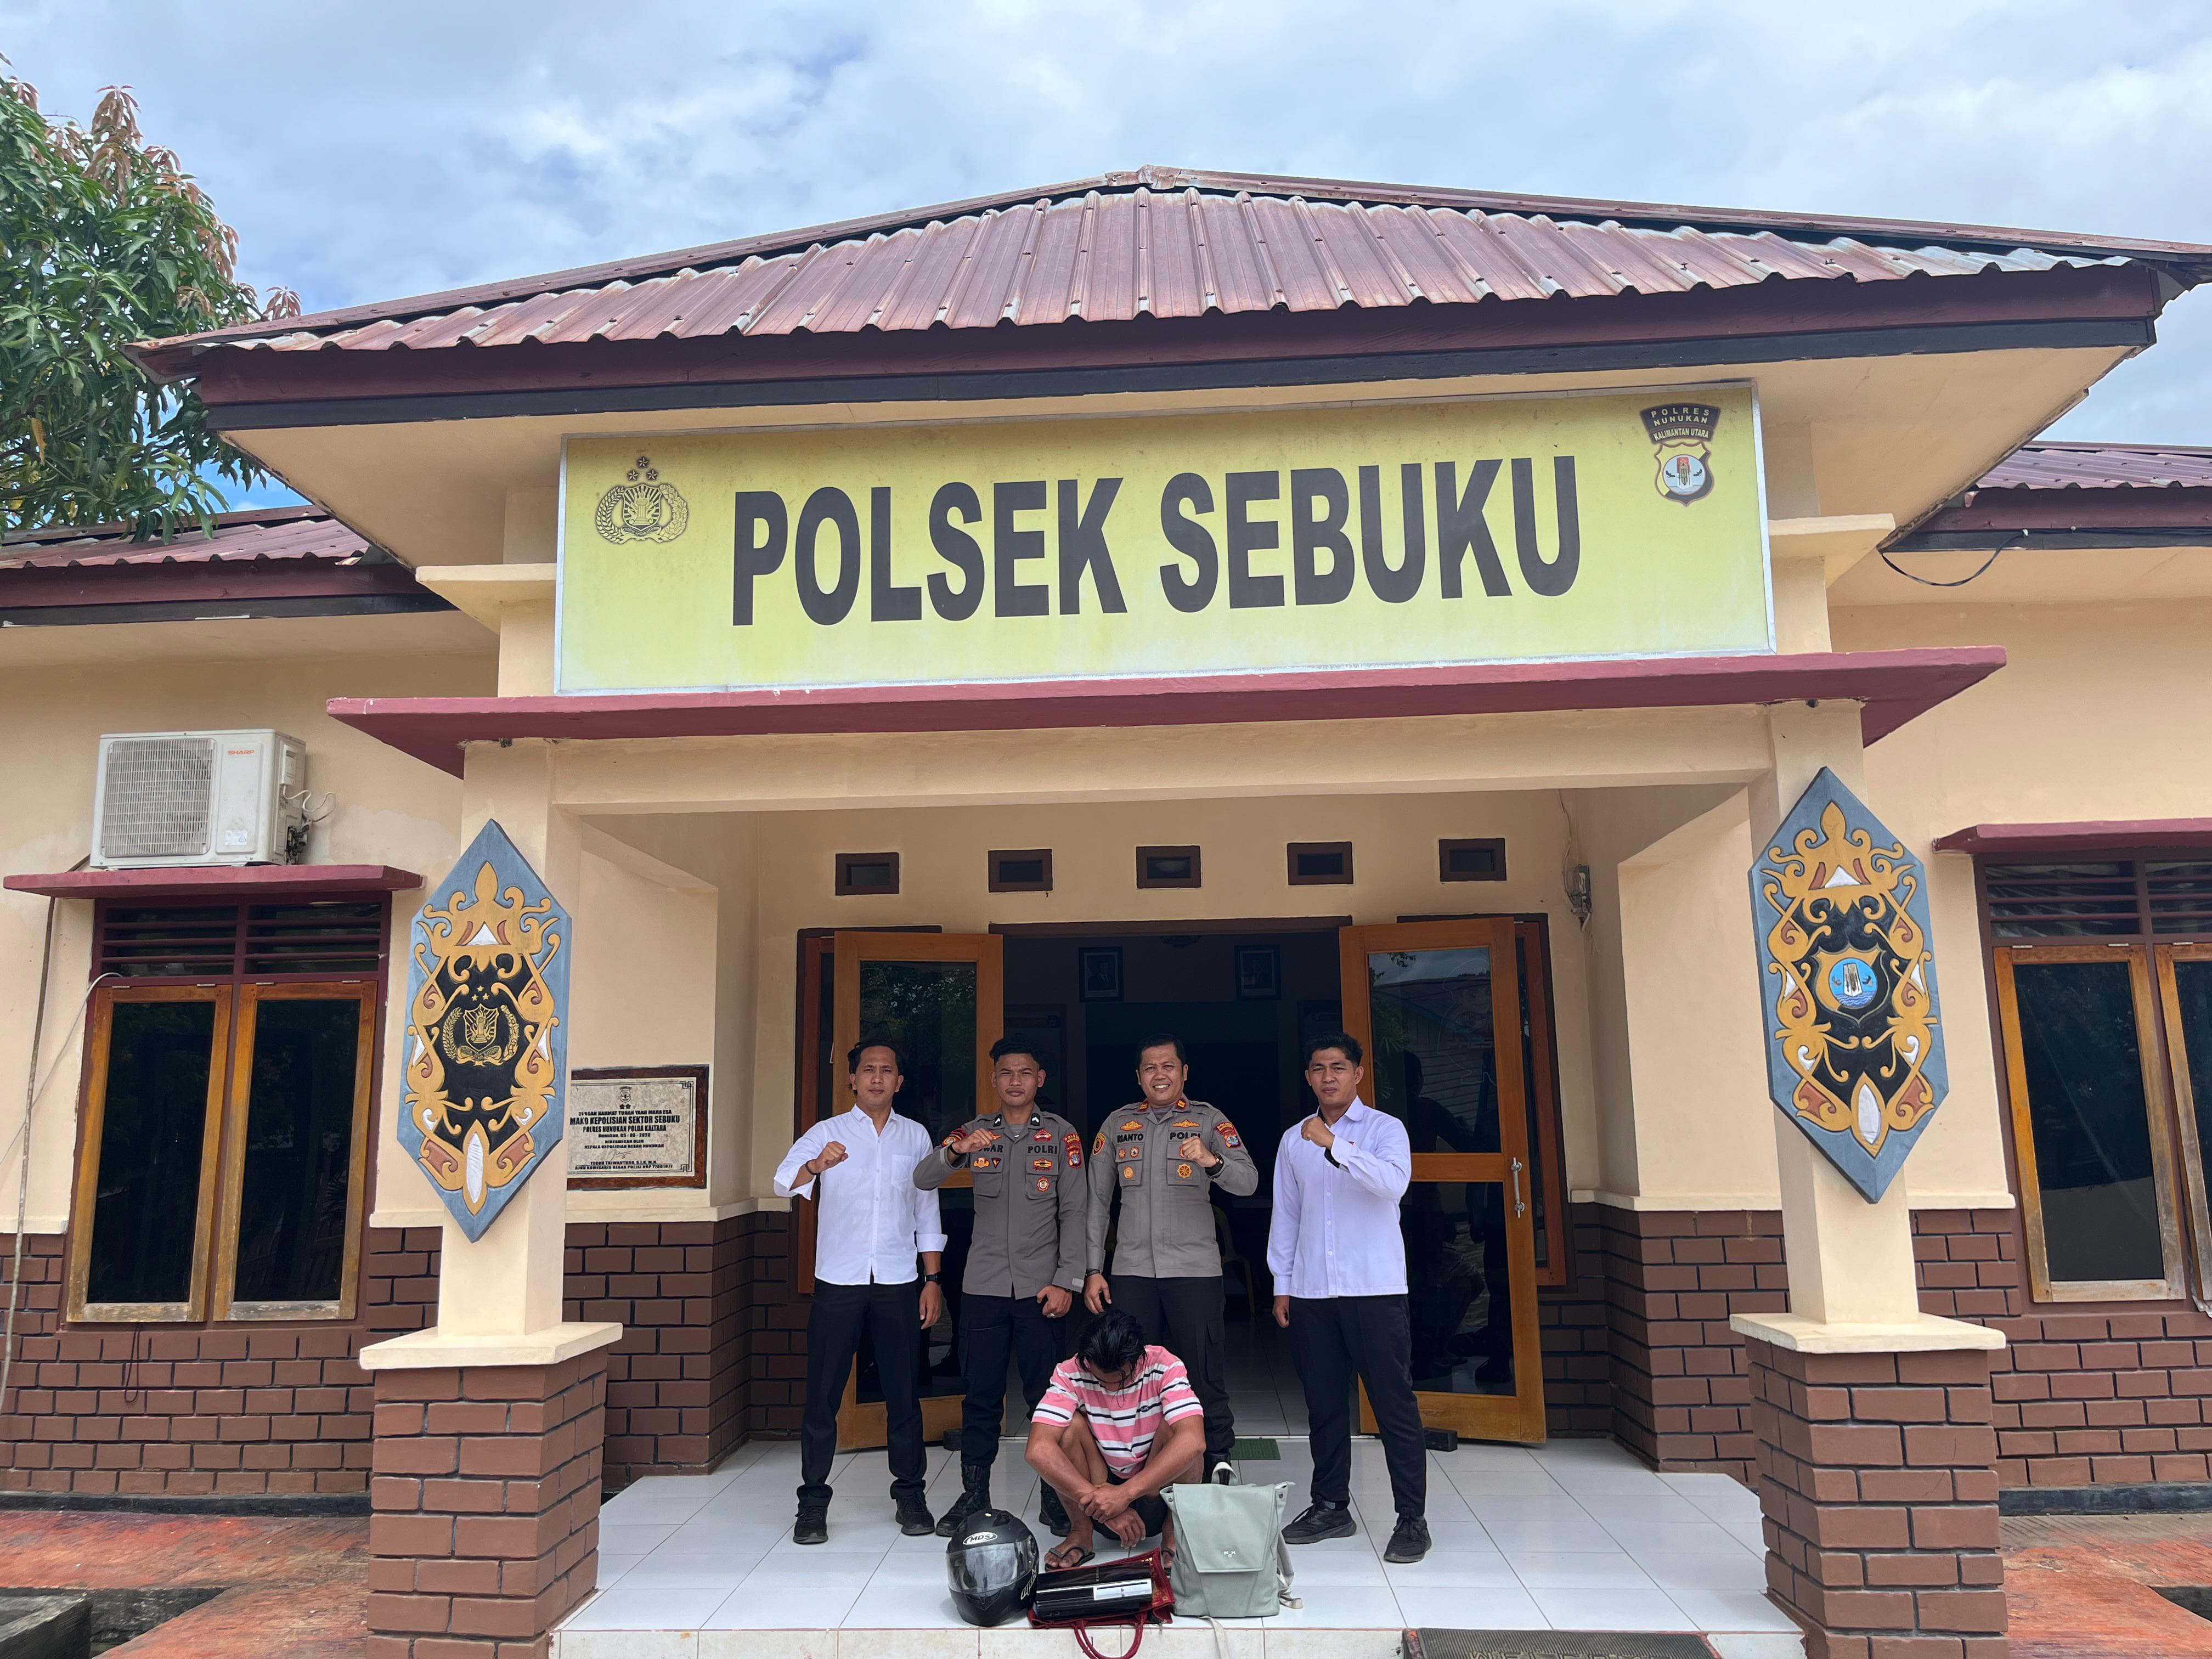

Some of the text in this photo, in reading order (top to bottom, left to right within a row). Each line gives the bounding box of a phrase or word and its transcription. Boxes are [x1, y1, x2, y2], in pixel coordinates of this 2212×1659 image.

[1651, 407, 1709, 418] POLRES
[1653, 415, 1707, 426] NUNUKAN
[1653, 428, 1709, 441] KALIMANTAN UTARA
[733, 455, 1581, 626] POLSEK SEBUKU
[590, 1116, 627, 1125] KEPOLISIAN
[1117, 1133, 1144, 1143] RIANTO
[1028, 1145, 1058, 1154] POLRI
[969, 1534, 990, 1543] MDS
